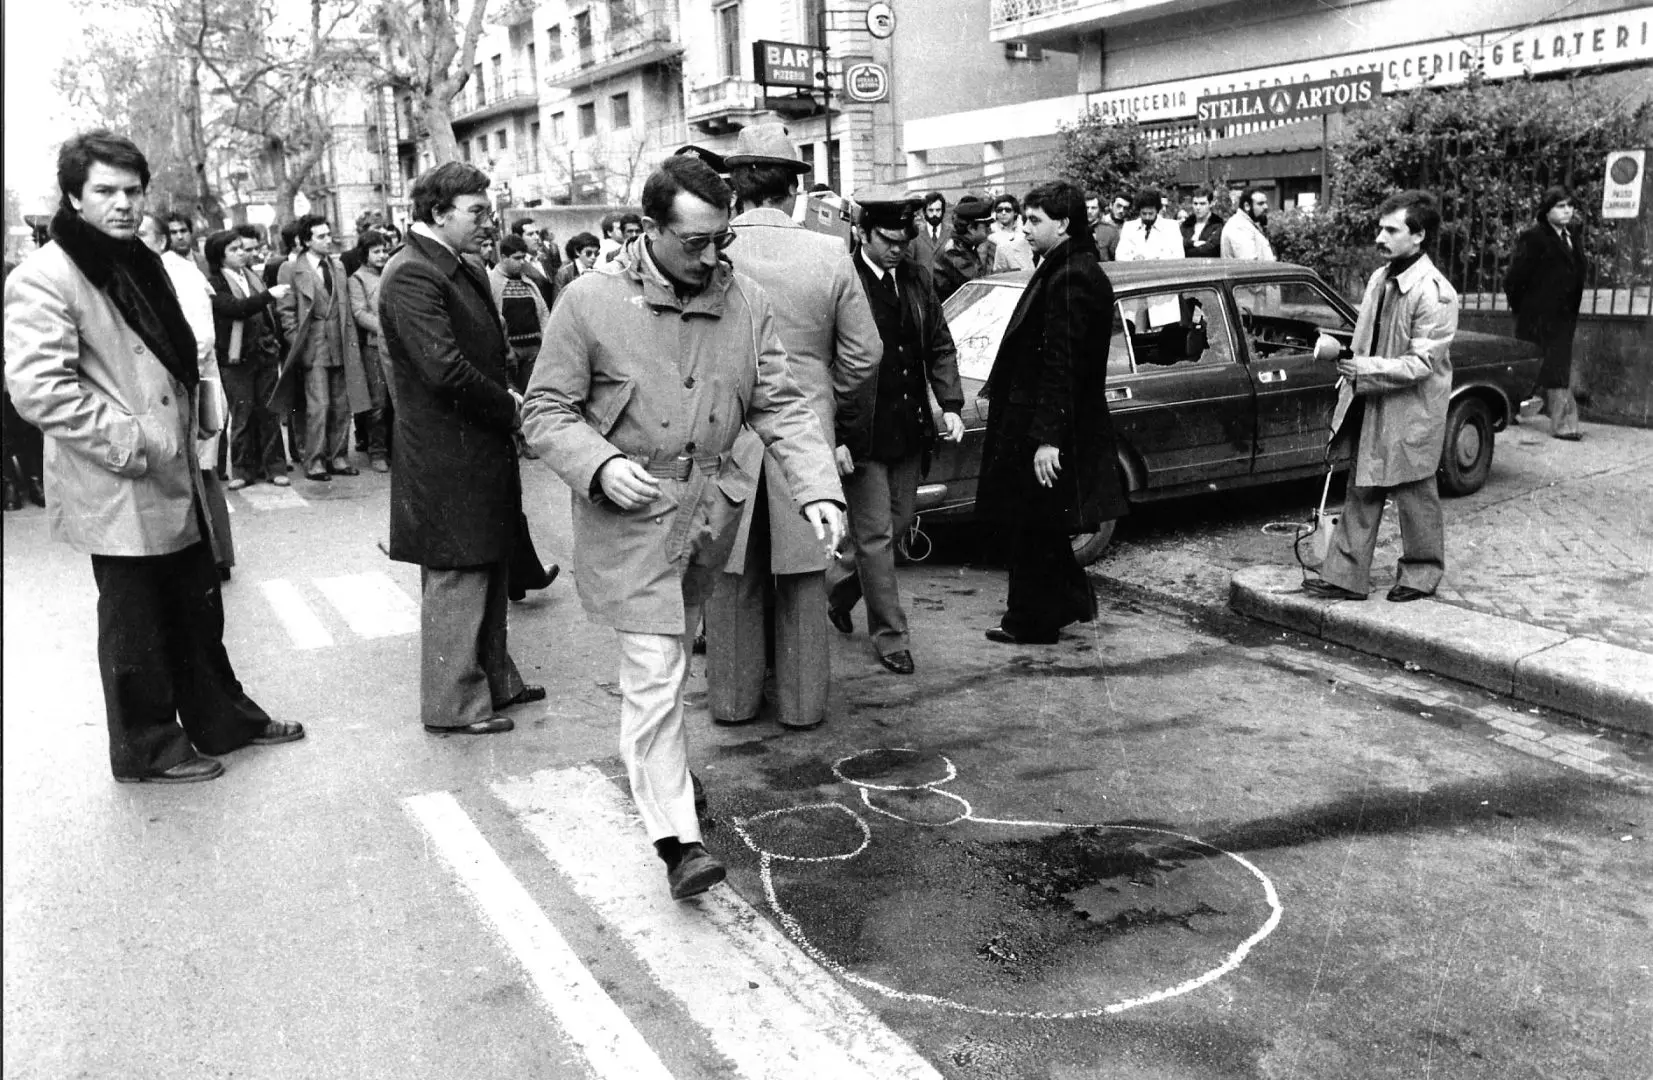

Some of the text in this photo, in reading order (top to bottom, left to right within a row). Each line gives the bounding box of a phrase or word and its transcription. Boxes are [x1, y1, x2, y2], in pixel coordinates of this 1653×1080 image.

[767, 46, 809, 68] BAR
[1492, 21, 1648, 66] GELATERI
[1198, 96, 1265, 121] STELLA
[1296, 80, 1372, 110] ARTOIS
